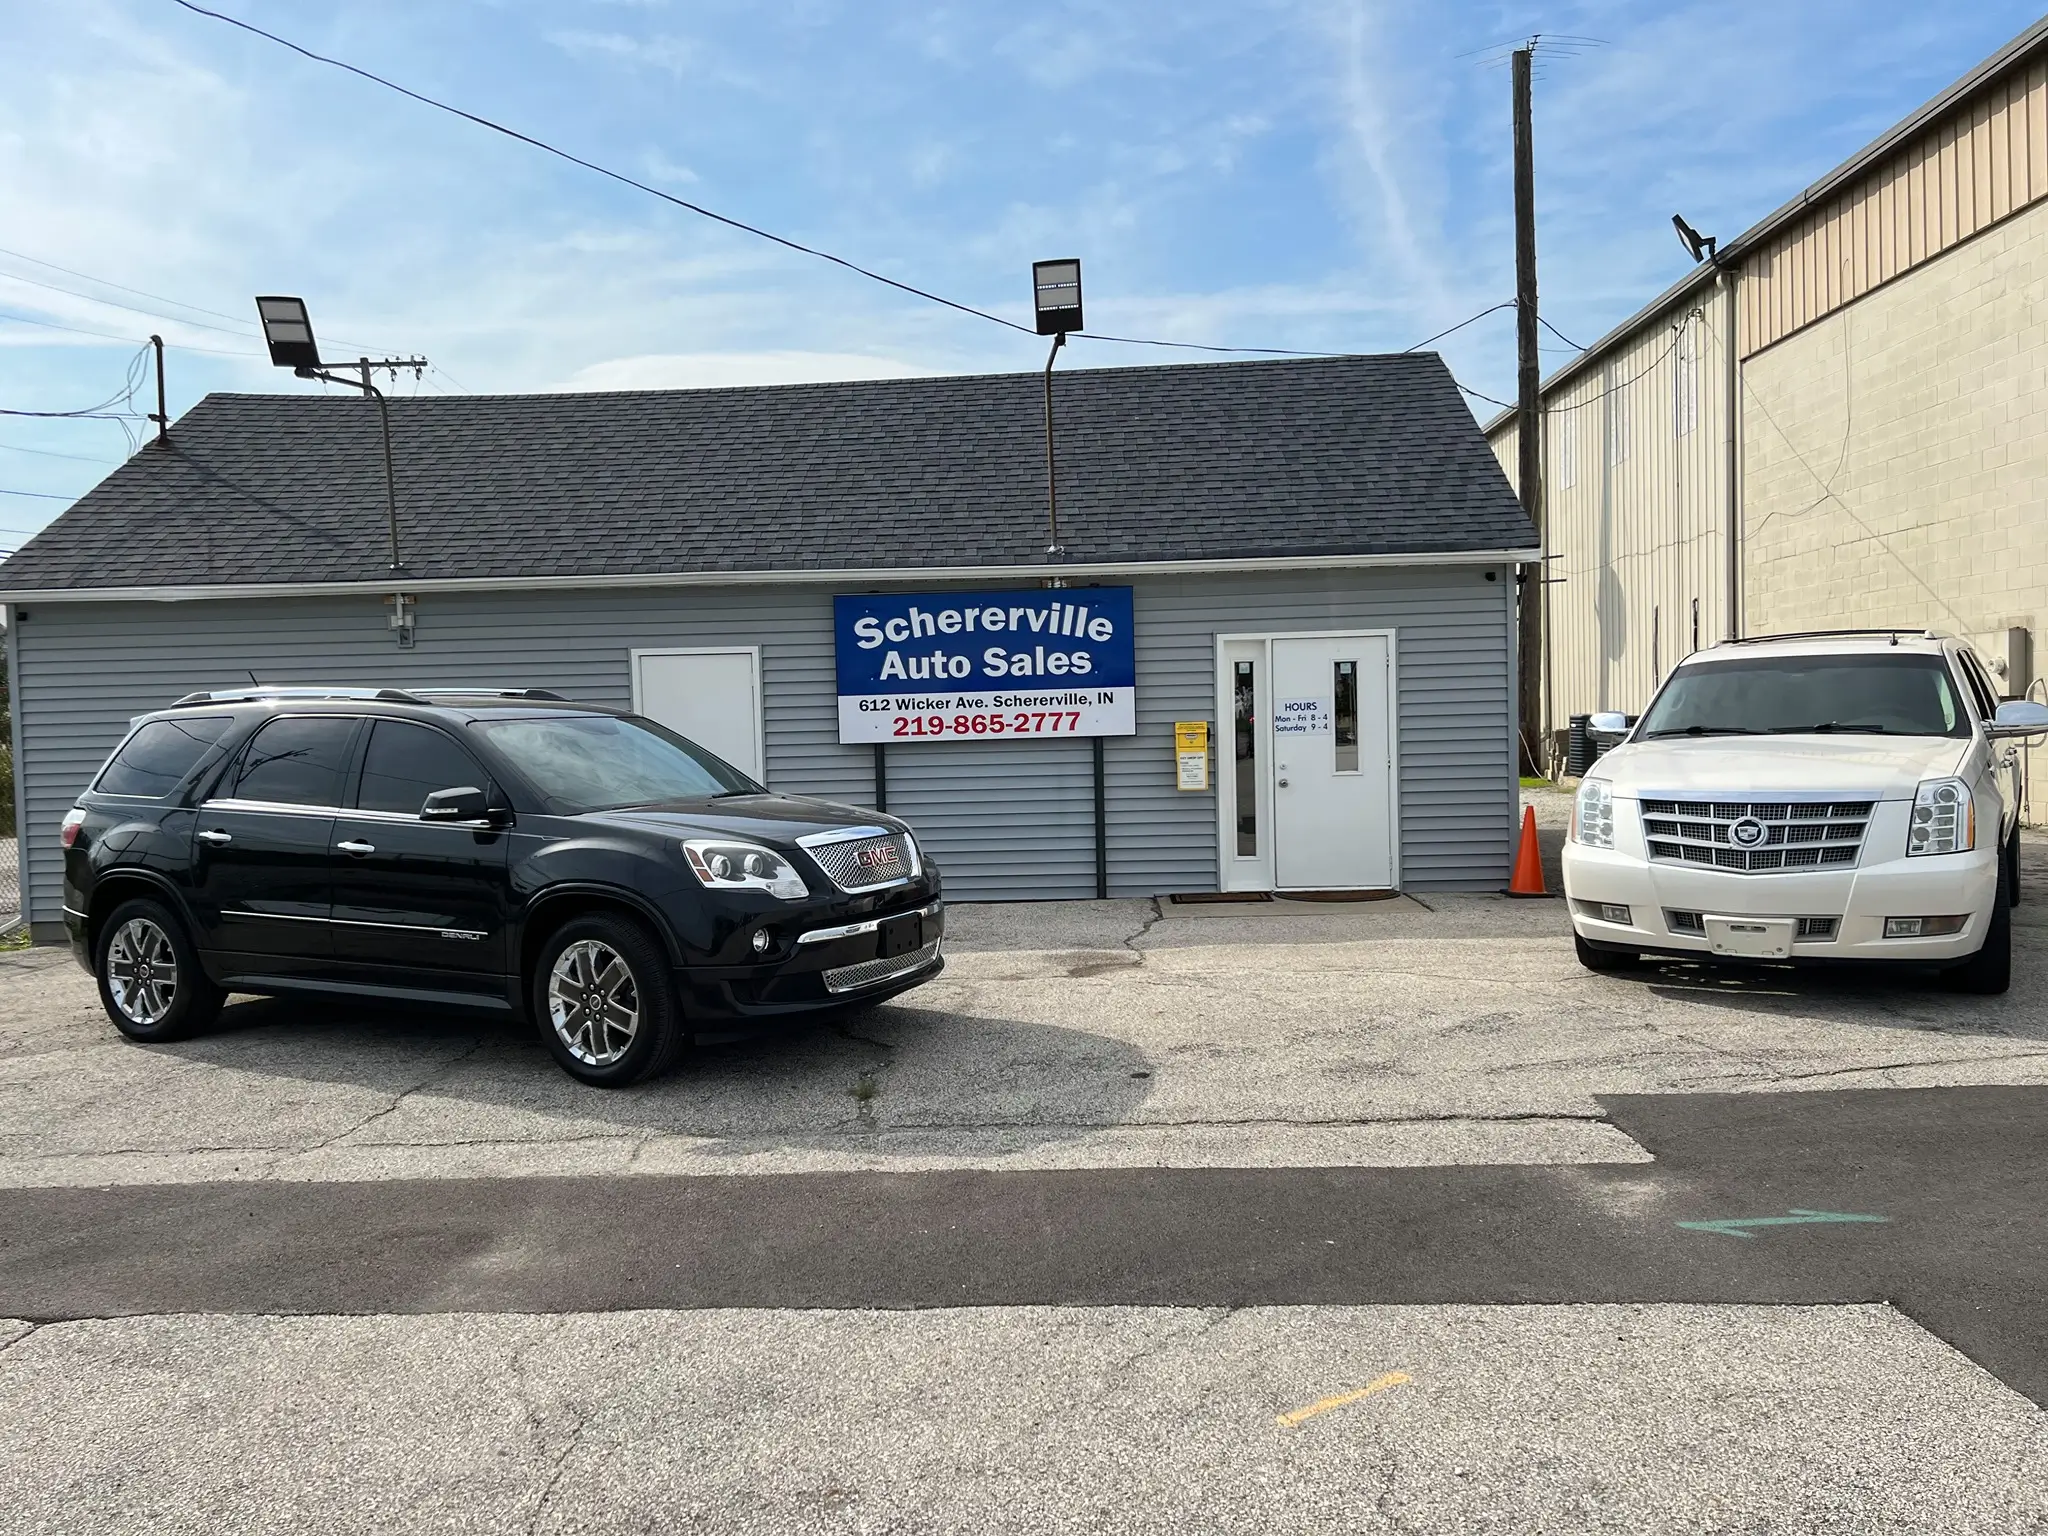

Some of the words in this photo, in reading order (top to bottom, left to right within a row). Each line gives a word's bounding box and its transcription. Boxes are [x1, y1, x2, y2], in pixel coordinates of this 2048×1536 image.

[853, 602, 1114, 650] Schererville
[879, 649, 972, 681] Auto
[982, 646, 1093, 678] Sales
[859, 699, 891, 712] 612
[895, 697, 951, 711] Wicker
[955, 696, 989, 710] Ave.
[993, 692, 1093, 708] Schererville,
[1097, 691, 1114, 705] IN
[1284, 702, 1318, 712] HOURS
[893, 711, 1081, 737] 219-865-2777
[1274, 715, 1291, 723] Mon
[1297, 714, 1307, 722] Fri
[1322, 713, 1328, 721] 4
[1275, 723, 1307, 733] Saturday
[1310, 723, 1316, 731] 9
[854, 846, 899, 867] GMC
